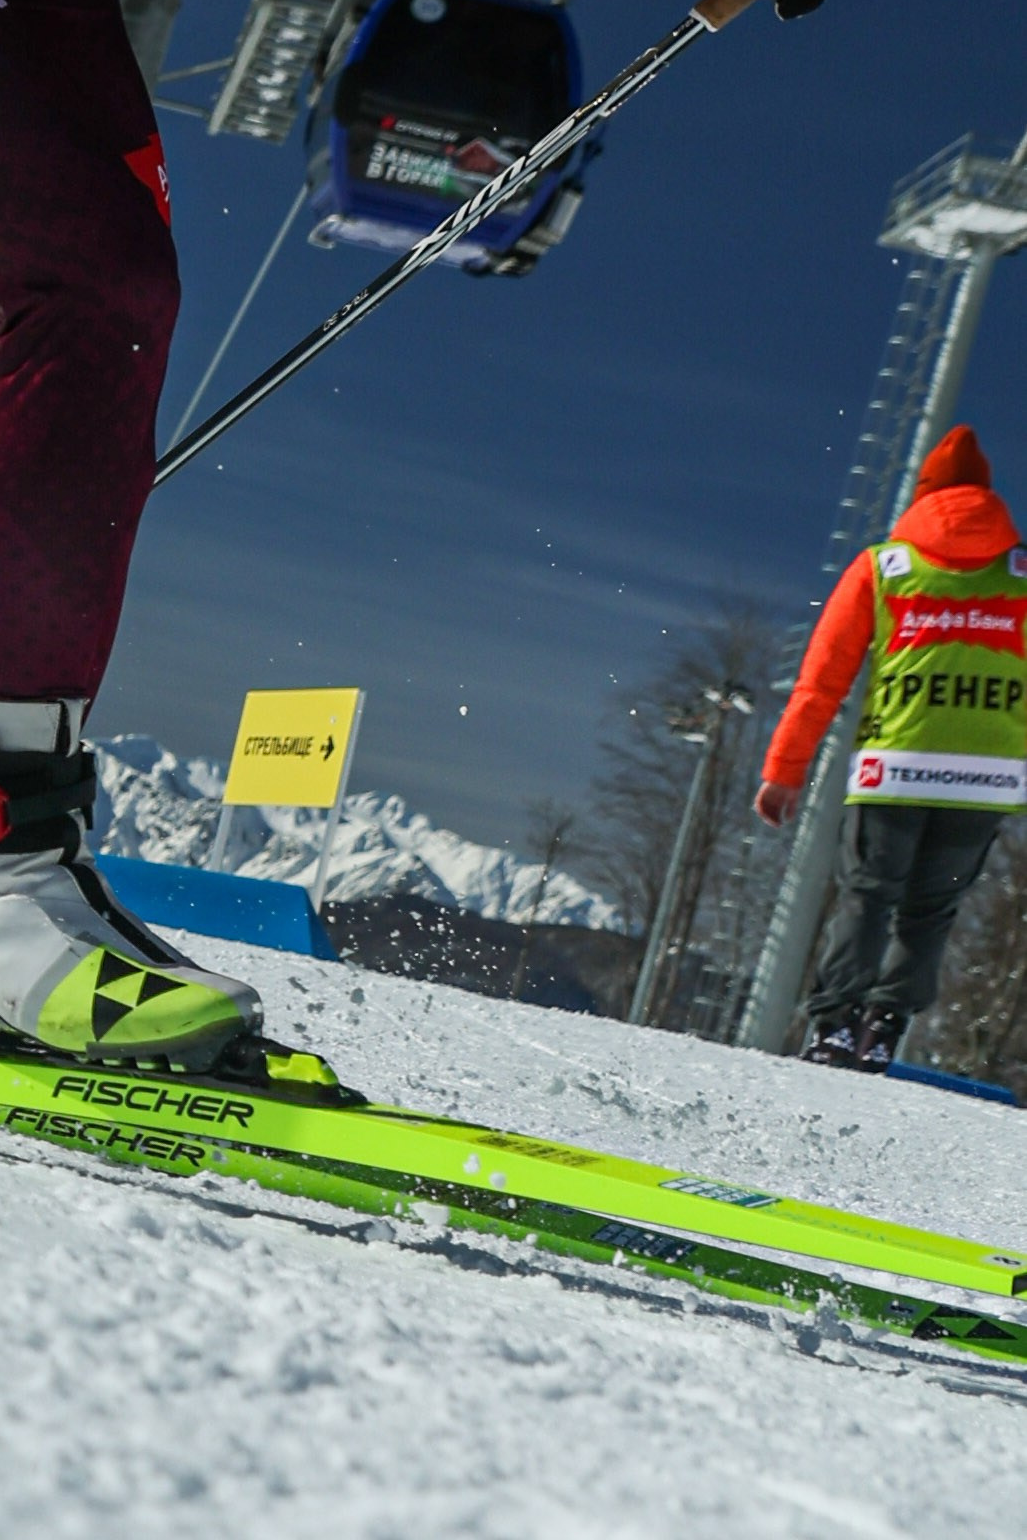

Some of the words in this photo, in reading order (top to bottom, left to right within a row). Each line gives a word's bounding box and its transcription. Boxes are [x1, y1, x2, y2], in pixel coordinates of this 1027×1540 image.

[899, 608, 966, 637] Альфа
[967, 608, 1015, 632] Банк
[882, 673, 1023, 710] ТРЕНЕР
[243, 735, 315, 759] СТРЕЛЬБИЩЕ
[51, 1075, 255, 1129] FISCHER
[4, 1106, 206, 1168] FISCHER
